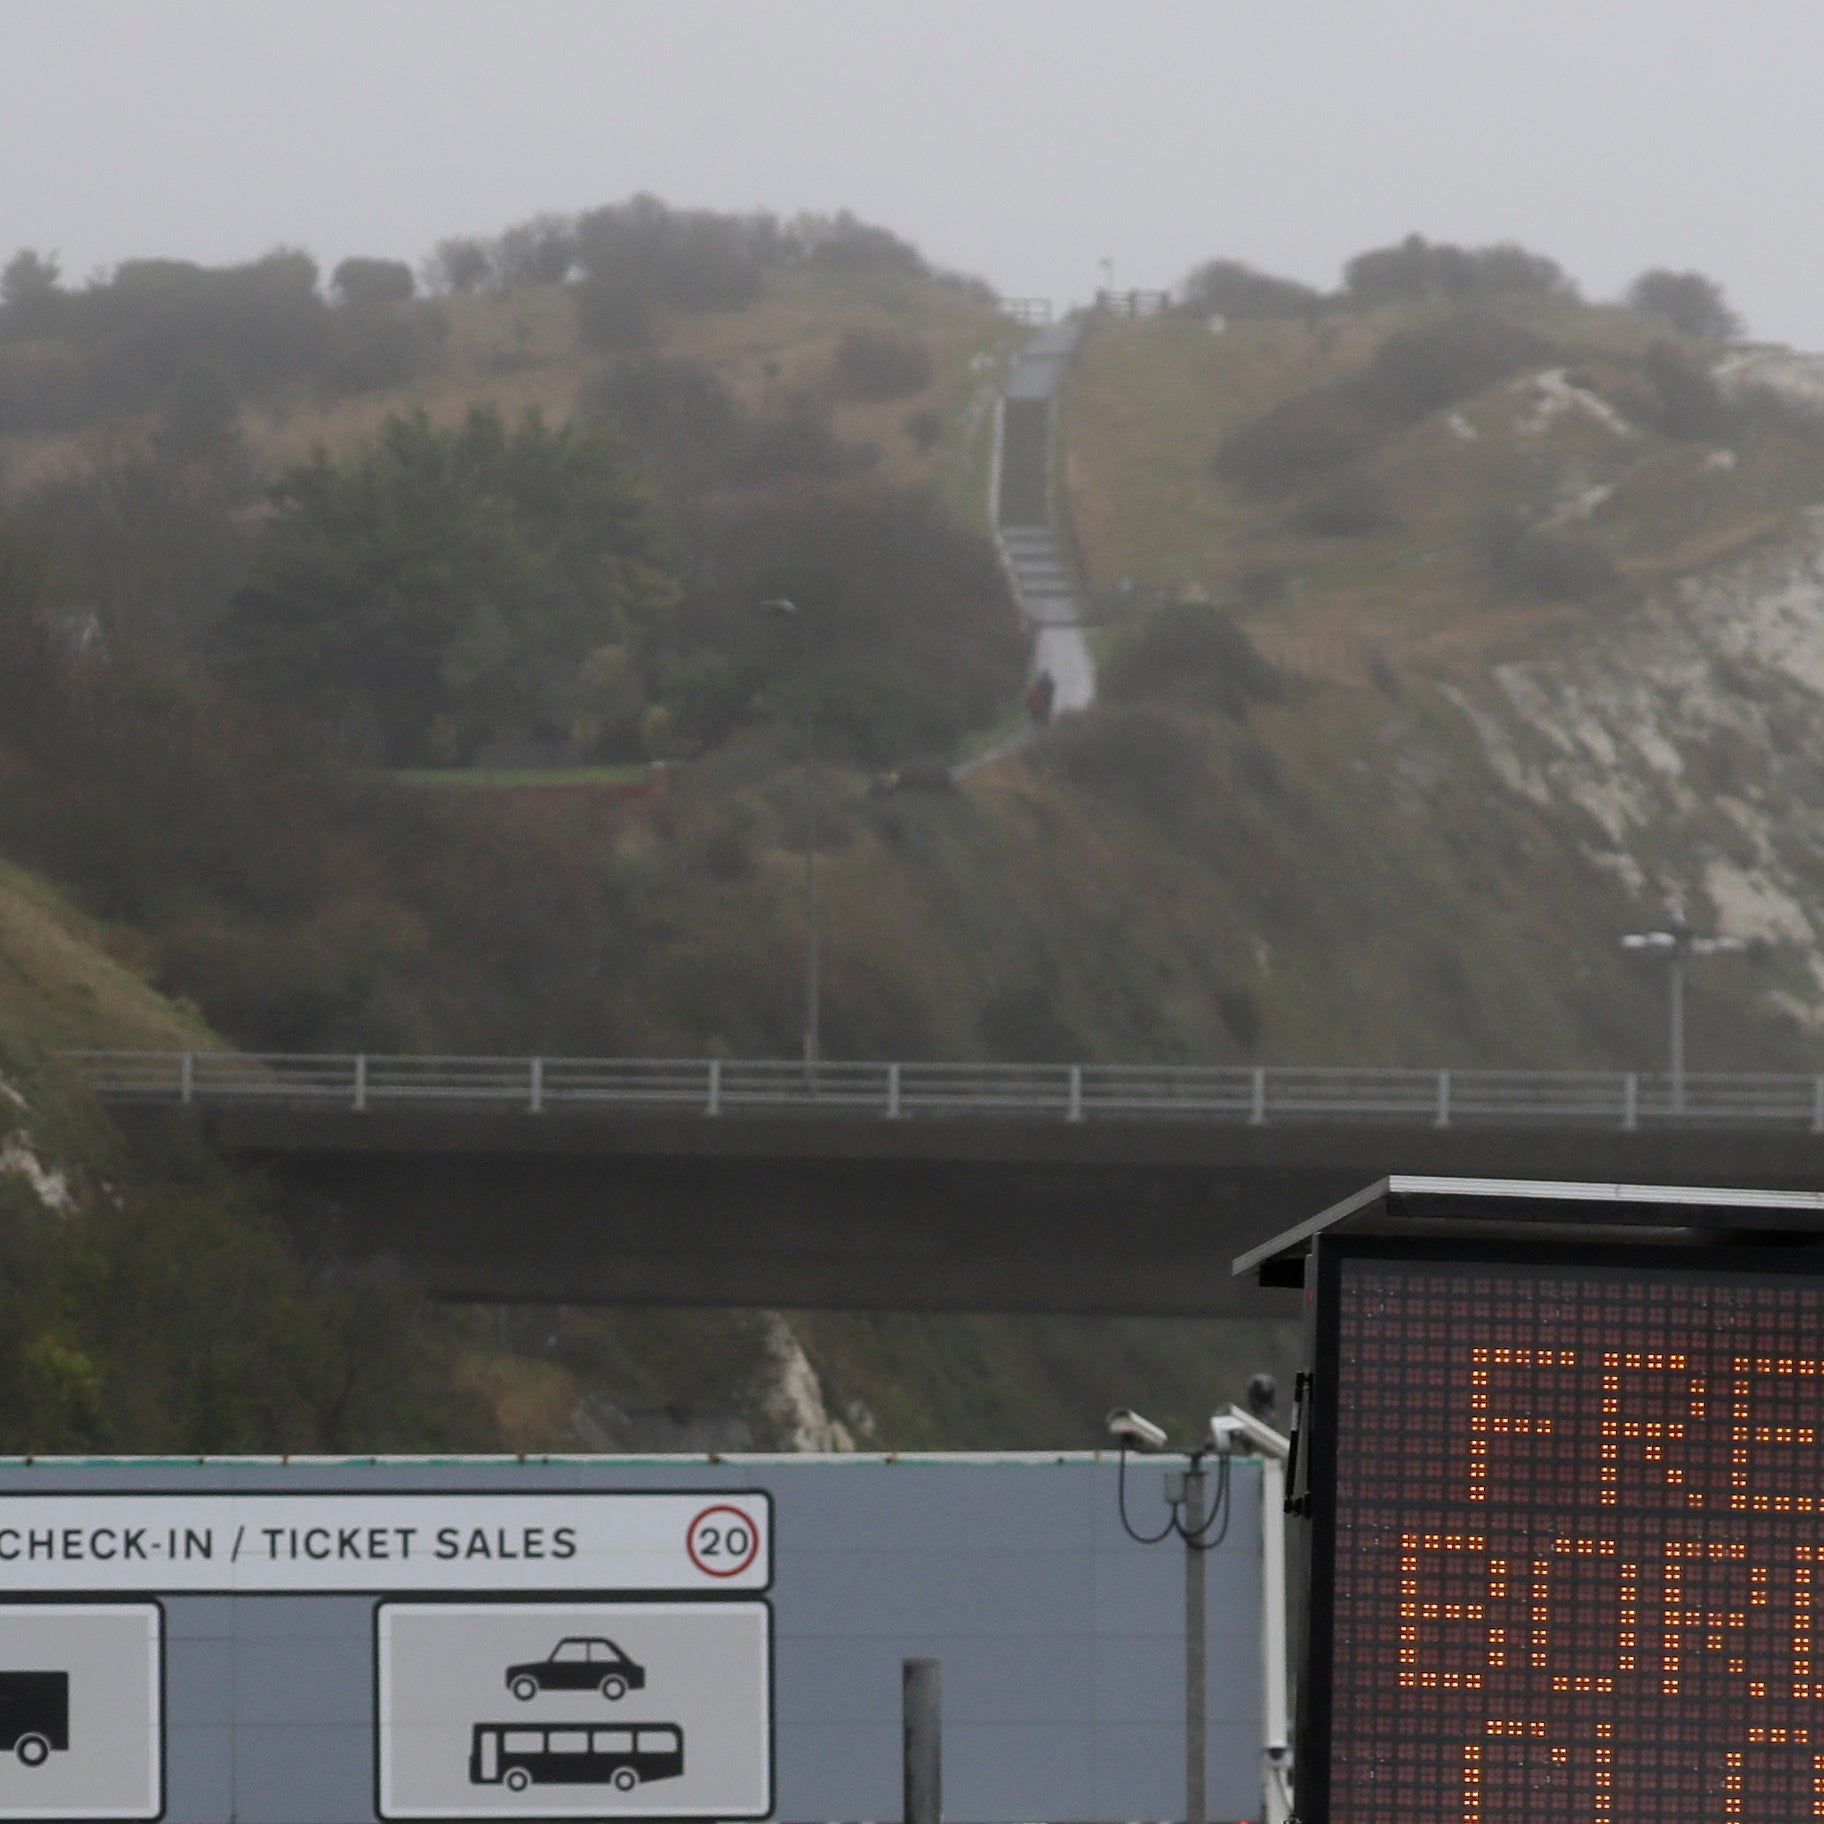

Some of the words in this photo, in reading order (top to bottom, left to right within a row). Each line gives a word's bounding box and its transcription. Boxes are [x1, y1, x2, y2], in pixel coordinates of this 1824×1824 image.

[230, 1526, 245, 1563] /
[262, 1526, 417, 1560] TICKET
[433, 1526, 578, 1560] SALES
[698, 1526, 751, 1557] 20
